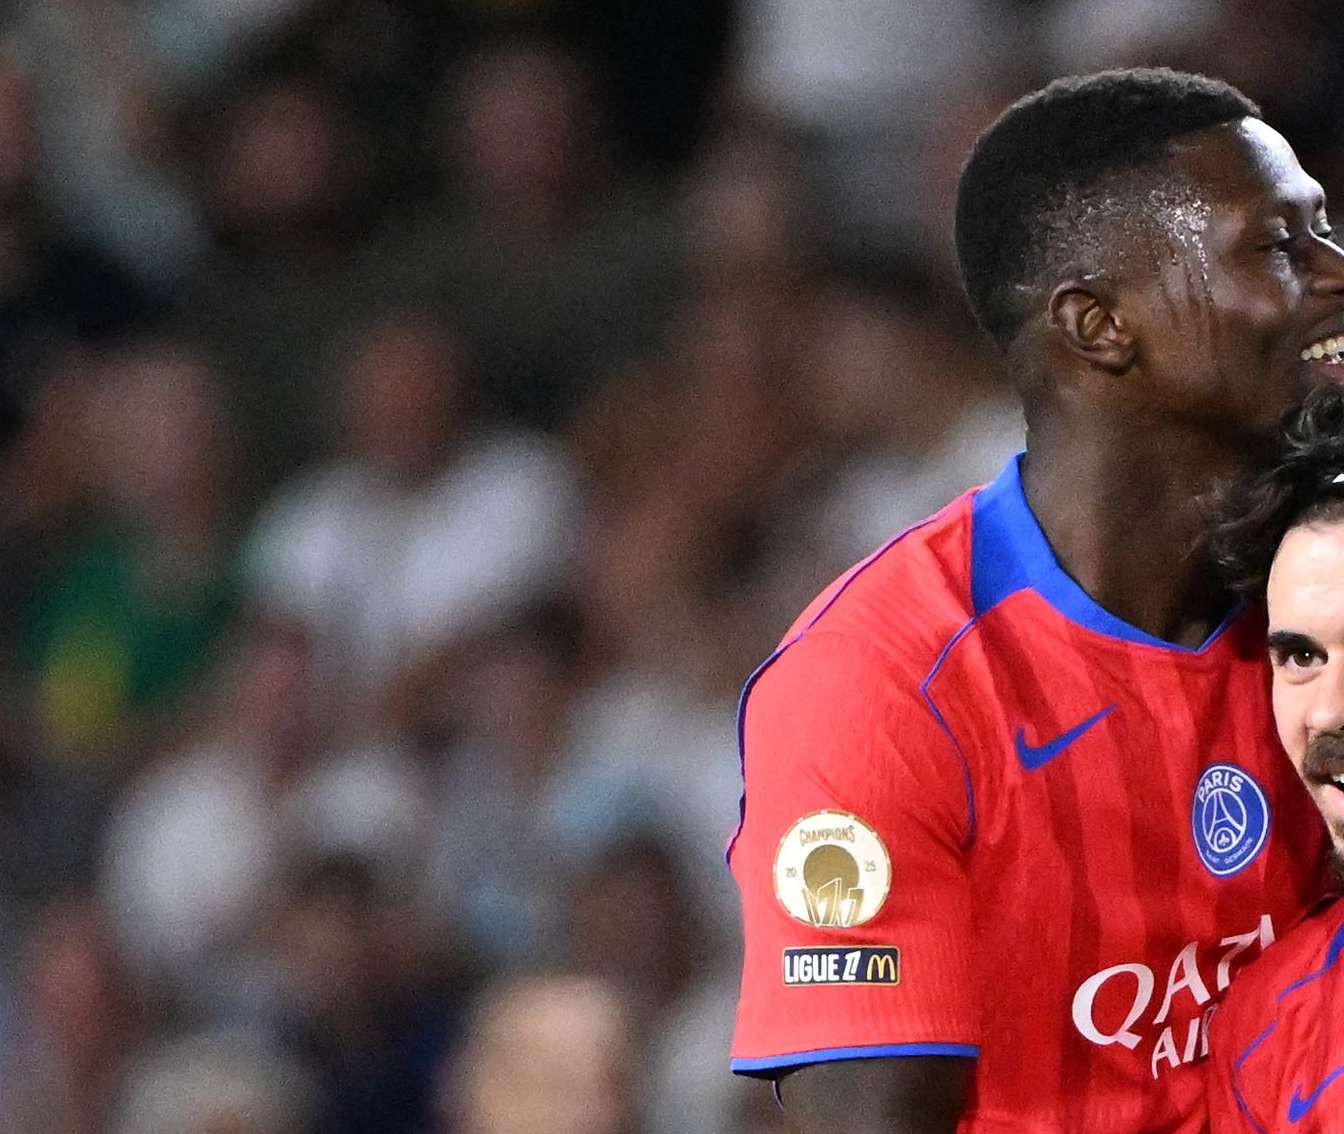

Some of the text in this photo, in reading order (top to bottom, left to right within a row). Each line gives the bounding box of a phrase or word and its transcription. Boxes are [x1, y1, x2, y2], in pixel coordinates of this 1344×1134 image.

[1198, 770, 1244, 803] PARIS
[799, 824, 856, 847] CHAMPIONS
[785, 860, 877, 878] 20 25
[784, 953, 840, 983] LIGUE
[1071, 913, 1276, 1050] QAT
